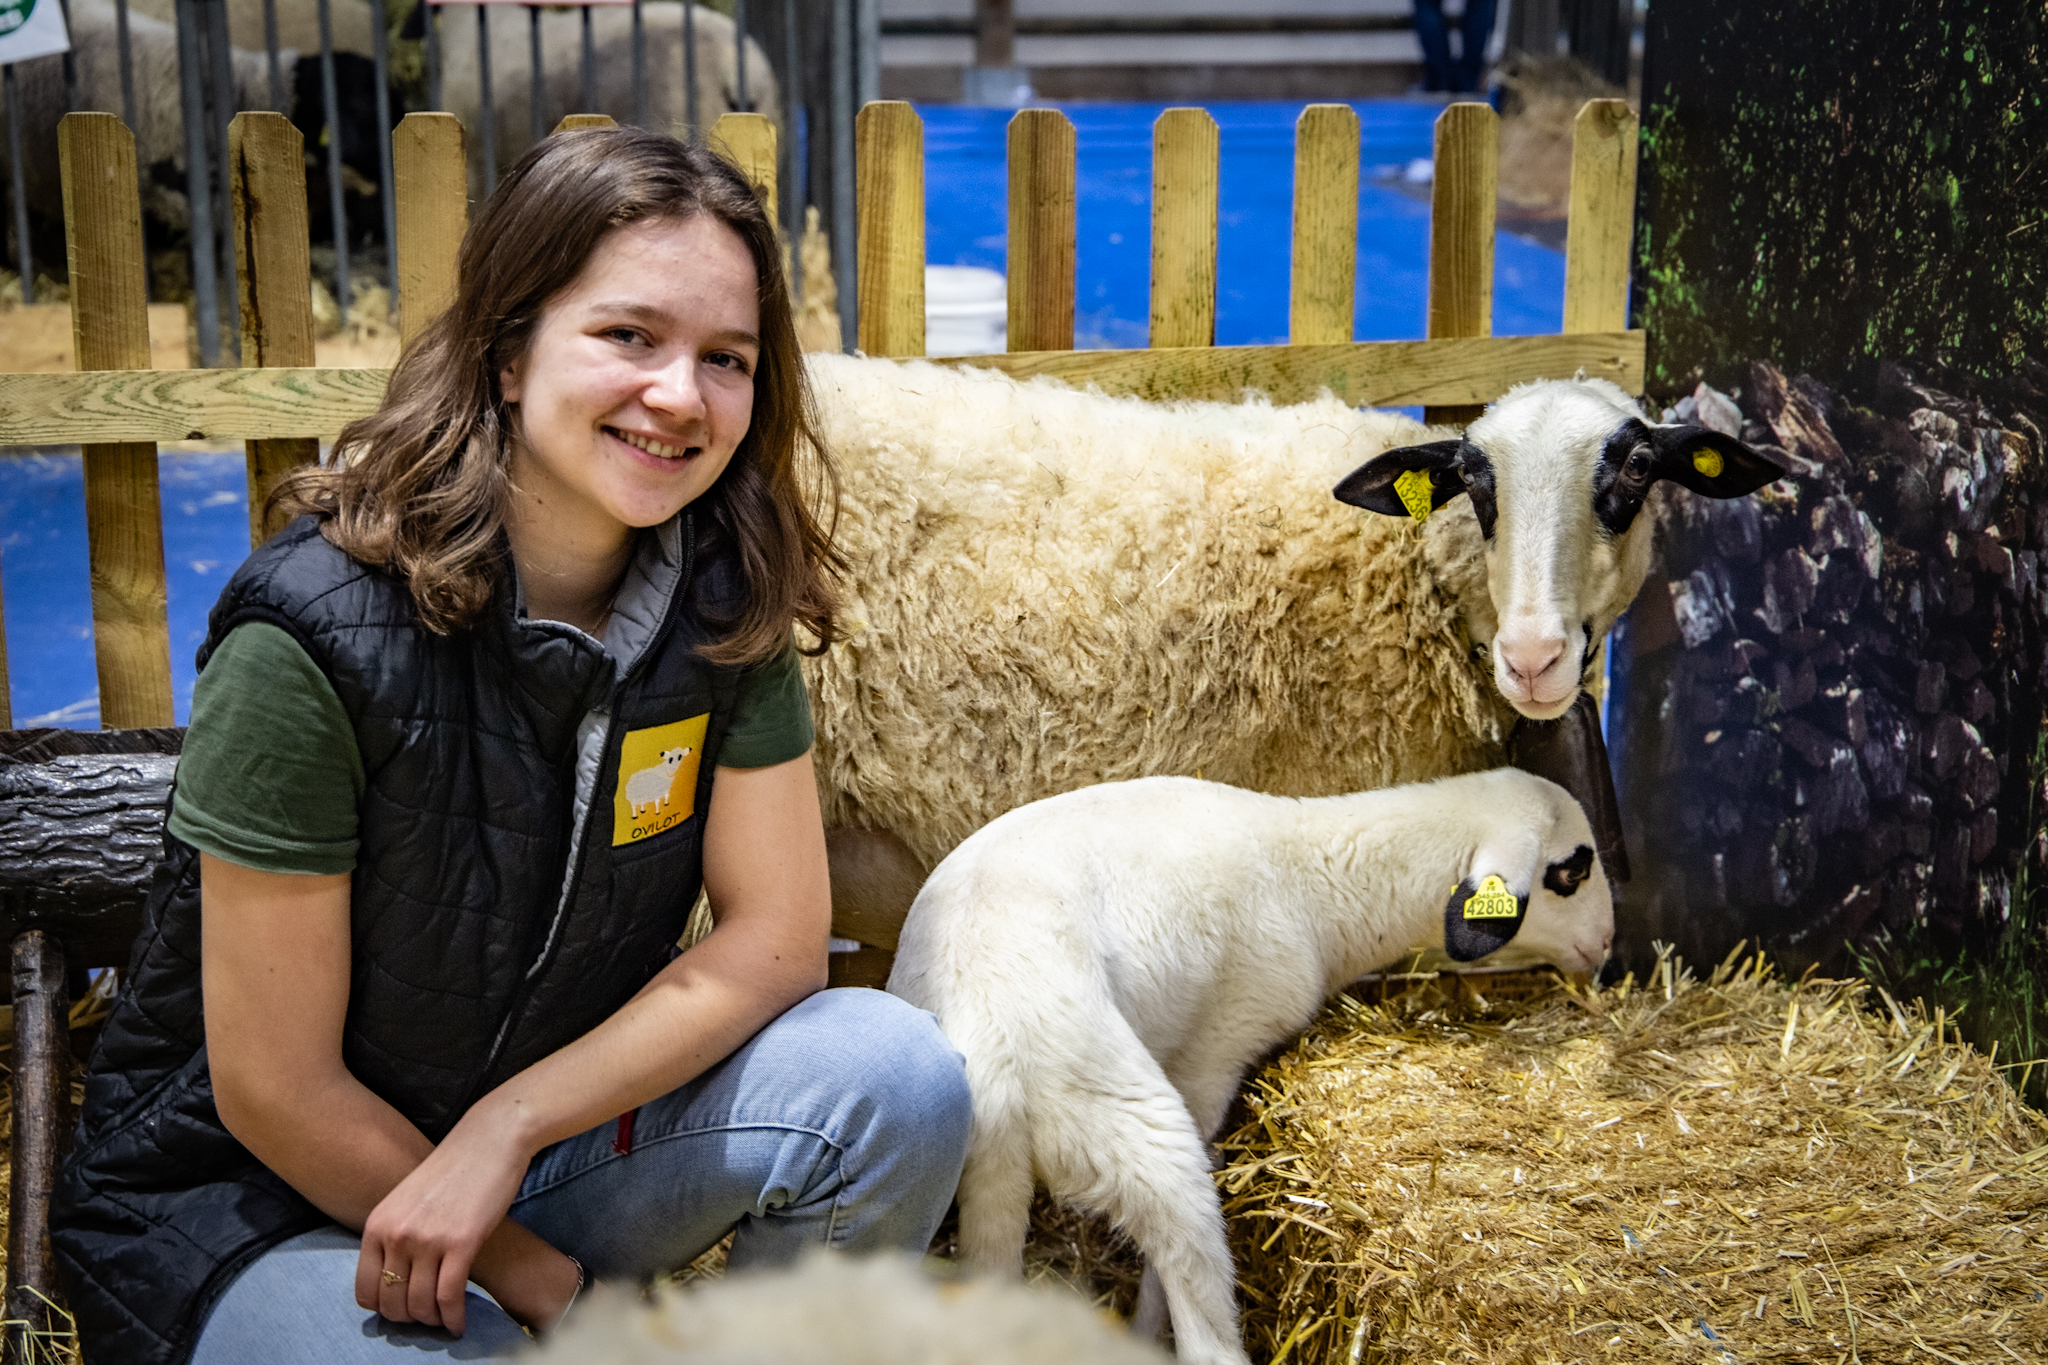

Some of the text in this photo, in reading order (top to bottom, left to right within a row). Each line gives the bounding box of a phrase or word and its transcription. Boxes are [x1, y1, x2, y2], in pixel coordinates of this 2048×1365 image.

[1397, 477, 1428, 521] 13236
[631, 812, 681, 839] OVILOT
[1466, 898, 1514, 916] 42803
